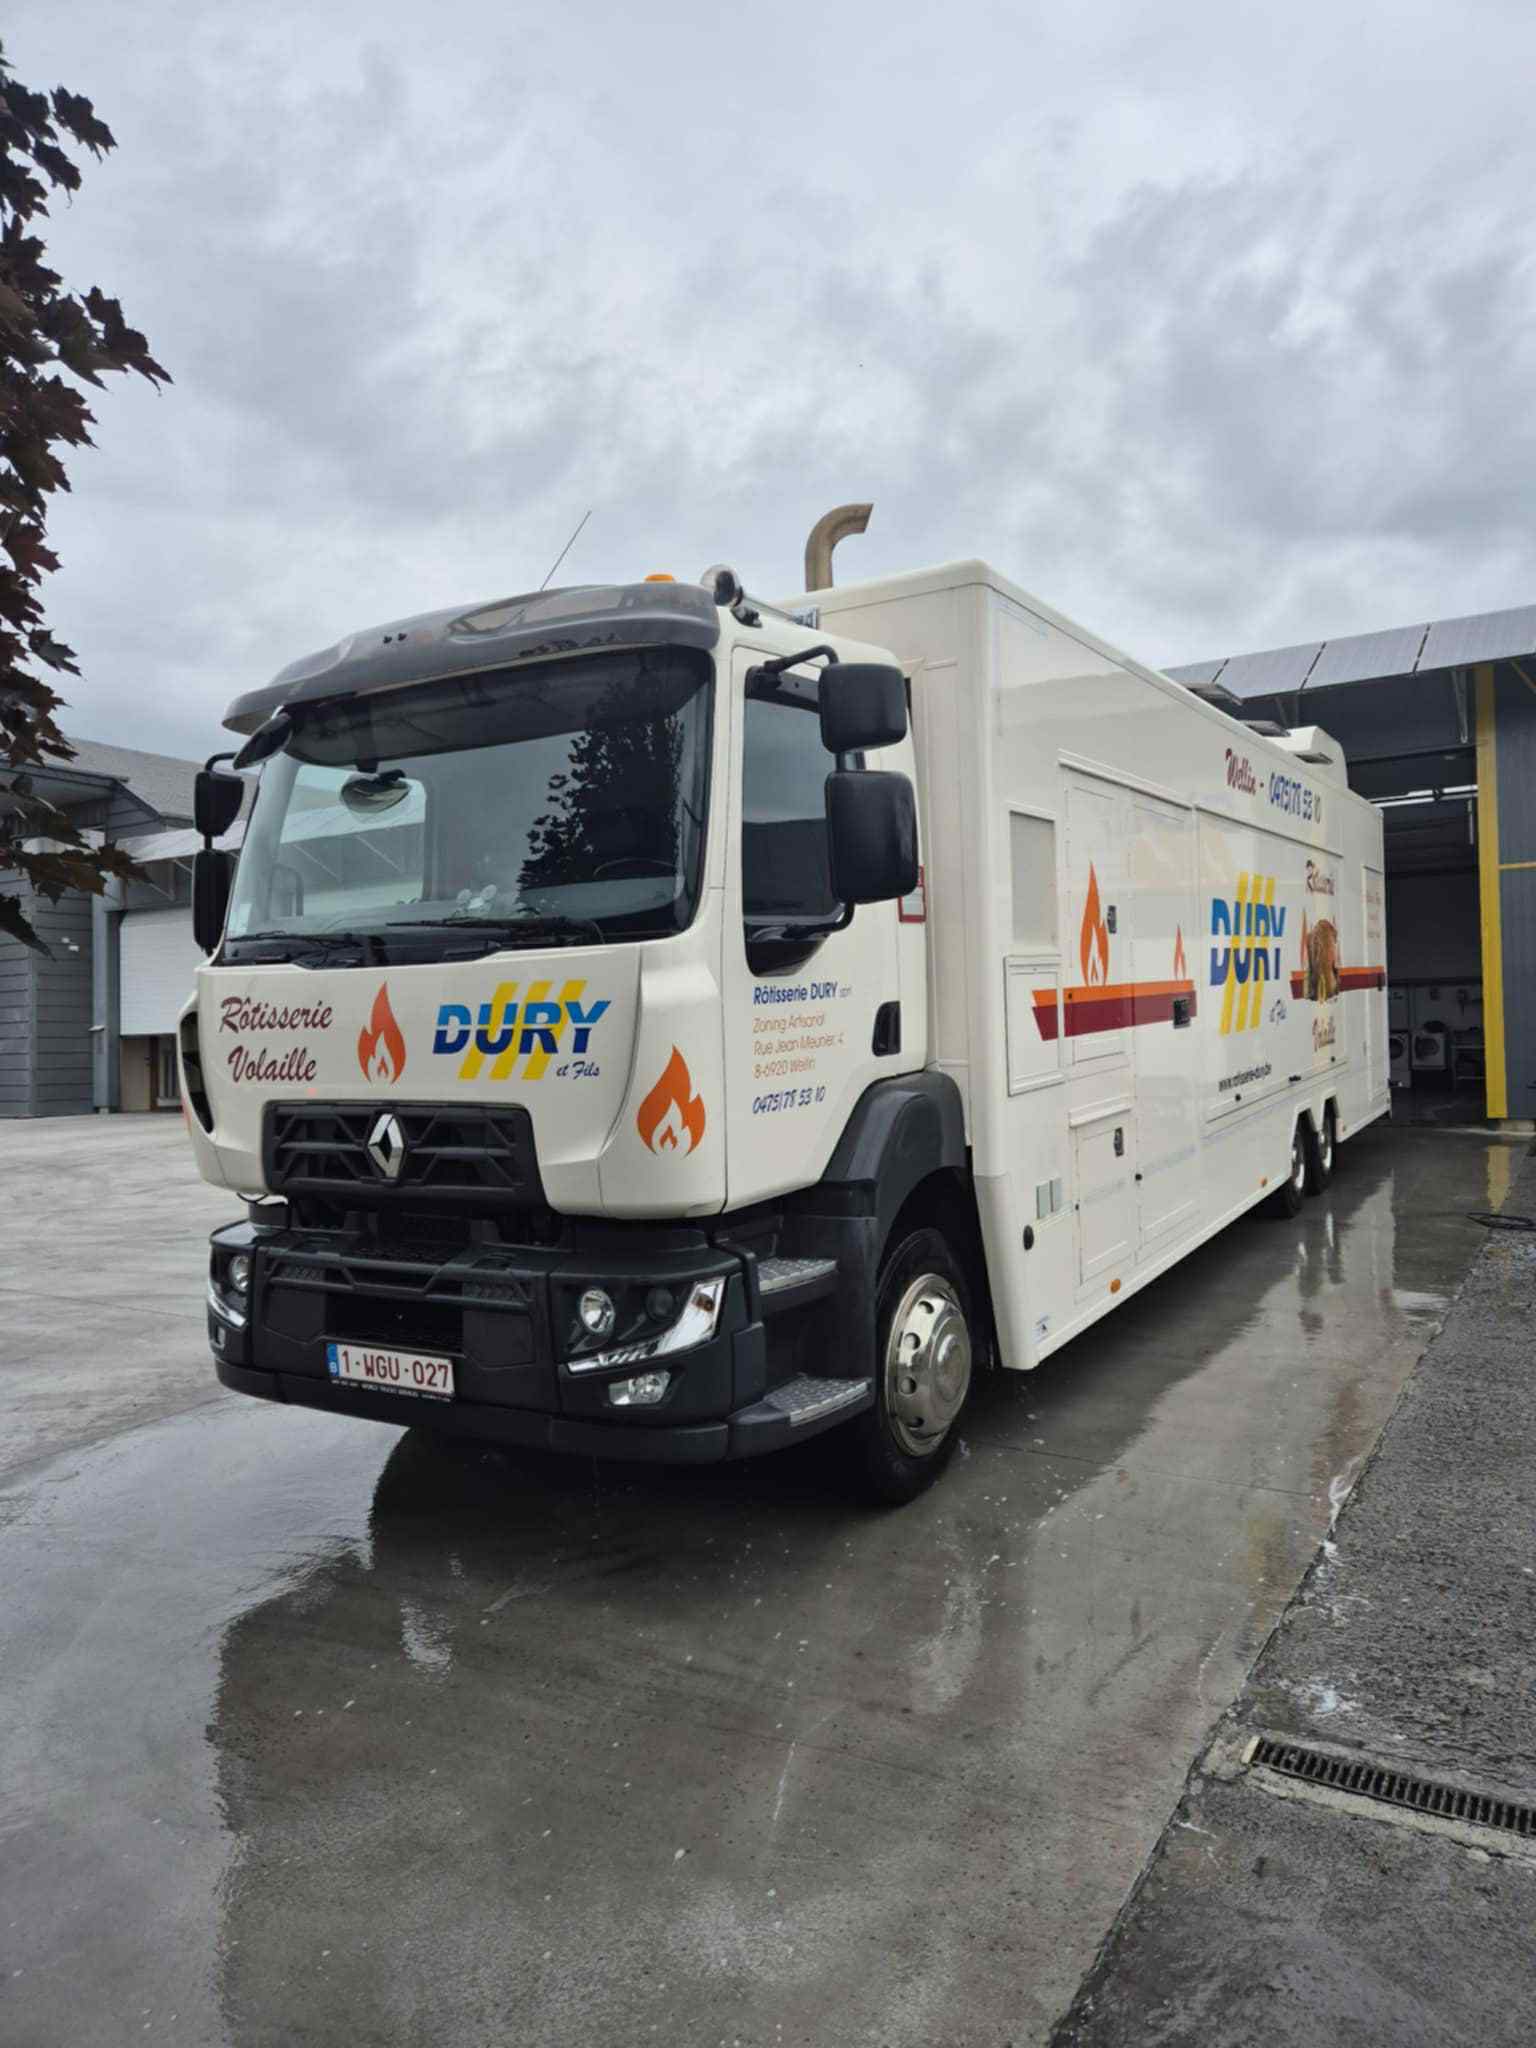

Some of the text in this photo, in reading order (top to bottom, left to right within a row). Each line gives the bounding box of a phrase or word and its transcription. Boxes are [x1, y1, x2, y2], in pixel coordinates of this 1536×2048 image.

[1210, 898, 1286, 985] DURY
[753, 984, 808, 1005] Rôtisserie
[810, 981, 839, 1000] DURY
[219, 996, 333, 1034] Rôtisserie
[432, 1000, 611, 1054] DURY
[753, 1016, 786, 1034] Zoning
[753, 1040, 774, 1056] Rue
[775, 1038, 800, 1053] Jean
[227, 1045, 317, 1083] Volaille
[556, 1060, 600, 1080] et Fils
[328, 1361, 338, 1374] B
